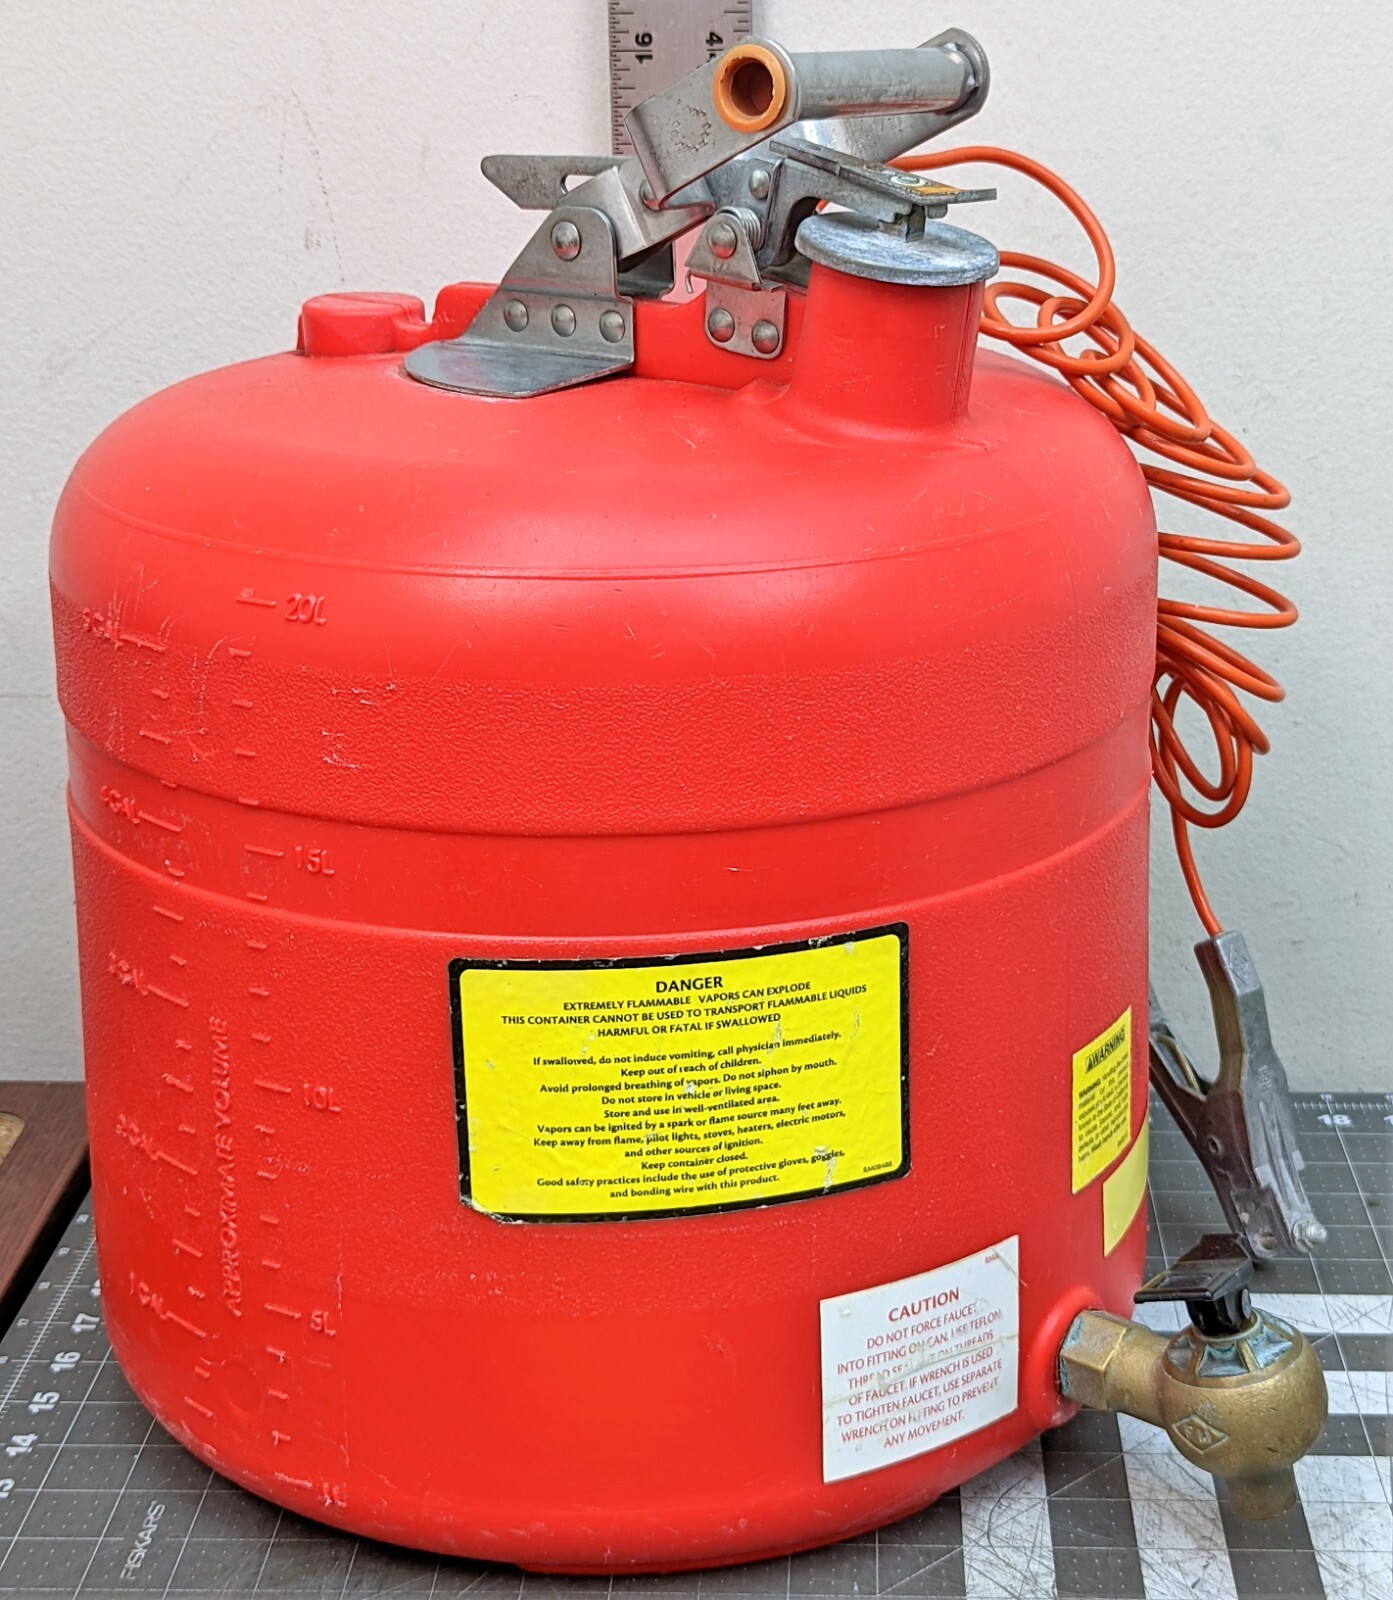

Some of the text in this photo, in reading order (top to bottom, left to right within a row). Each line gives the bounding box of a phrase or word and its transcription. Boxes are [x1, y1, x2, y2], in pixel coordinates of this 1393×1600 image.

[635, 32, 653, 64] 16
[284, 592, 328, 626] 20L
[295, 846, 335, 877] 15L
[564, 982, 810, 1010] EXTREMELY FLAMMABLE VAPORS CAN EXPLODE
[656, 976, 723, 993] DANGER
[502, 985, 866, 1024] THIS CONTAINER CANNOT BE USED TO TRANSPORT FLAMMABLE LIQUIDS
[598, 1013, 781, 1037] HARMFUL OR FATAL IF SWALLOWED
[533, 1057, 540, 1065] If
[543, 1056, 596, 1065] swallowed,
[598, 1056, 612, 1064] do
[634, 1053, 667, 1062] induce
[718, 1046, 734, 1056] call
[736, 1041, 780, 1056] physician
[782, 1031, 841, 1047] immediately.
[1093, 1028, 1125, 1065] WARNING
[540, 1084, 569, 1093] Avoid
[572, 1082, 622, 1094] prolonged
[624, 1080, 672, 1090] breathing
[674, 1077, 684, 1087] of
[723, 1073, 737, 1082] Do
[739, 1071, 755, 1080] not
[757, 1067, 789, 1079] siphon
[791, 1064, 802, 1074] by
[804, 1058, 837, 1070] mouth.
[621, 1058, 762, 1078] Keep out of reach of children.
[303, 1083, 341, 1113] 10L
[602, 1096, 616, 1105] Do
[618, 1096, 635, 1104] not
[638, 1095, 662, 1103] store
[665, 1092, 674, 1101] in
[677, 1090, 711, 1100] vehicle
[725, 1085, 751, 1095] living
[753, 1082, 781, 1093] space.
[604, 1110, 630, 1118] Store
[632, 1107, 651, 1117] and
[672, 1105, 682, 1114] in
[683, 1097, 755, 1113] well-ventilated
[757, 1096, 780, 1104] area.
[534, 1111, 846, 1148] Keep away from flame, pilot lights, stoves, heaters, electric motors,
[537, 1125, 572, 1135] Vapors
[594, 1123, 606, 1132] be
[608, 1121, 642, 1133] ignited
[645, 1120, 657, 1131] by
[667, 1118, 694, 1130] spark
[709, 1115, 735, 1125] flame
[737, 1111, 768, 1121] source
[770, 1107, 796, 1118] many
[798, 1102, 815, 1112] feet
[817, 1098, 842, 1110] away.
[1317, 1114, 1351, 1126] 18
[624, 1138, 763, 1157] and other sources of ignition.
[641, 1151, 748, 1171] Keep container closed.
[537, 1178, 563, 1186] Good
[596, 1176, 640, 1187] practices
[643, 1173, 678, 1183] include
[681, 1172, 697, 1180] the
[700, 1171, 715, 1179] use
[717, 1167, 727, 1176] of
[729, 1162, 776, 1177] protective
[778, 1157, 809, 1169] gloves,
[610, 1175, 779, 1198] and bonding wire with this product.
[888, 1287, 959, 1322] CAUTION
[71, 1312, 100, 1334] 17
[311, 1310, 336, 1336] 5L
[867, 1336, 884, 1349] DO
[886, 1327, 908, 1343] NOT
[911, 1317, 941, 1336] FORCE
[50, 1351, 81, 1373] 16
[837, 1358, 864, 1374] INTO
[867, 1346, 906, 1367] FITTING
[848, 1393, 862, 1406] OF
[909, 1376, 917, 1388] IF
[920, 1362, 960, 1384] WRENCH
[962, 1359, 969, 1368] IS
[971, 1347, 993, 1364] USED
[28, 1391, 60, 1414] 15
[837, 1414, 852, 1426] TO
[856, 1401, 900, 1421] TIGHTEN
[943, 1378, 959, 1393] USE
[961, 1359, 1002, 1386] SEPARATE
[842, 1424, 887, 1442] WRENCH
[890, 1415, 906, 1428] ON
[948, 1395, 960, 1408] TO
[962, 1378, 998, 1402] PREVENT
[884, 1411, 964, 1448] ANY MOVEMENT.
[5, 1433, 39, 1457] 14
[120, 1501, 165, 1579] FISKARS
